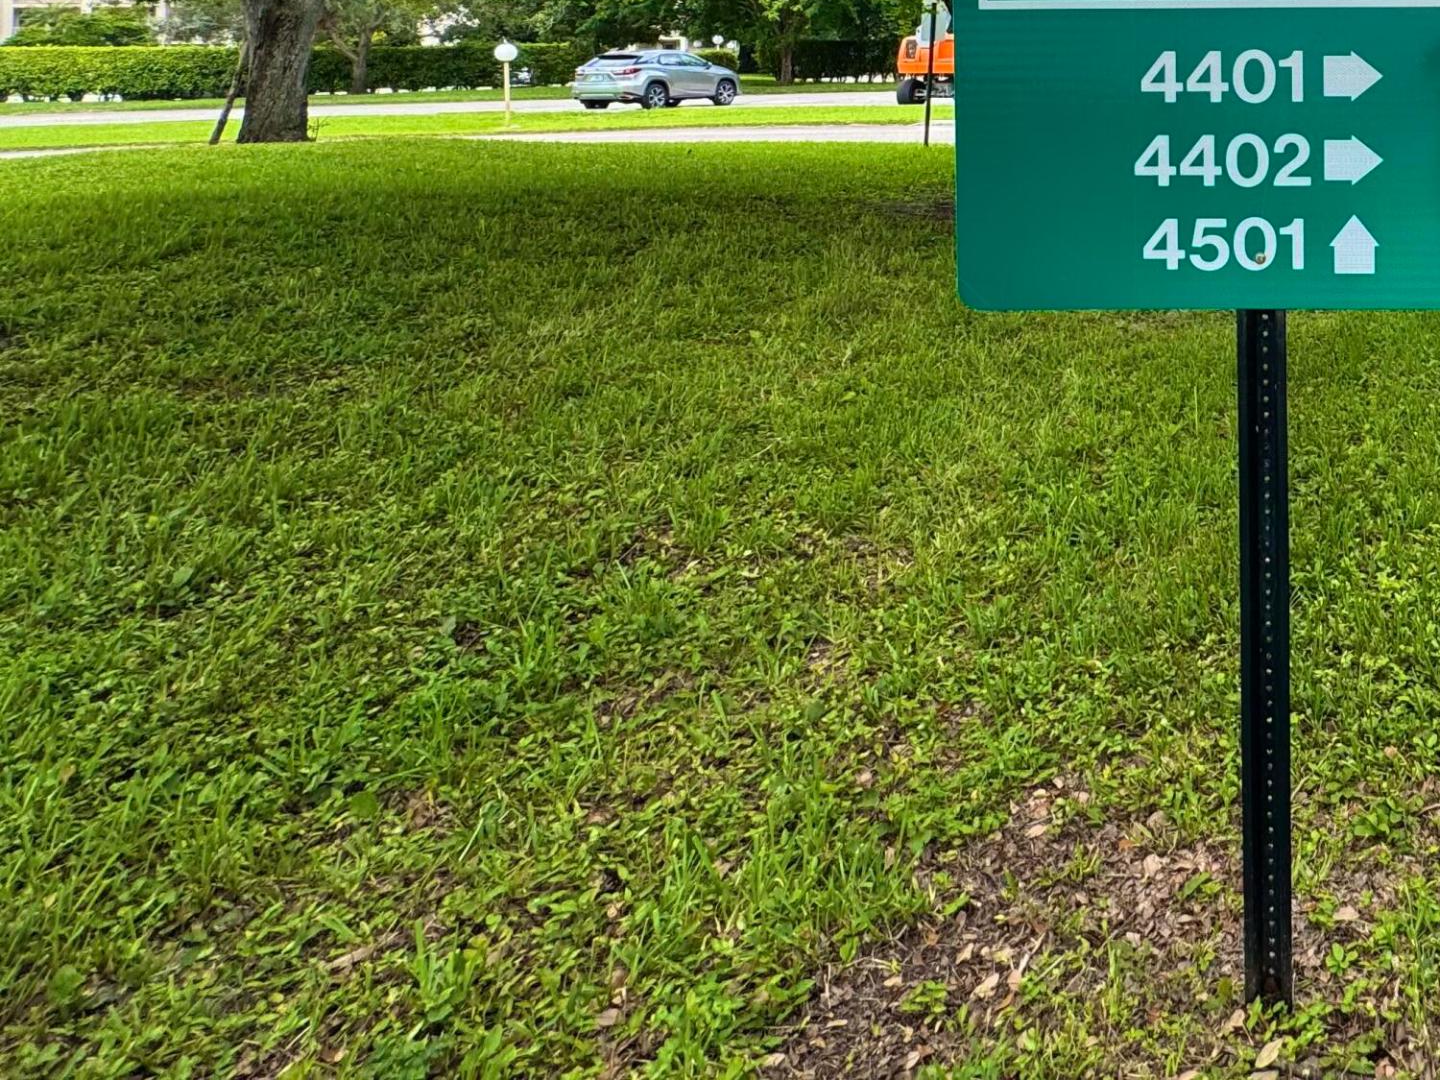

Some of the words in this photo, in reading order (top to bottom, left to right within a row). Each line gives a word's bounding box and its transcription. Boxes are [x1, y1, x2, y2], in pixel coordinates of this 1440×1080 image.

[1140, 49, 1304, 104] 4401
[1134, 133, 1312, 188] 4402
[1143, 217, 1304, 272] 4501
